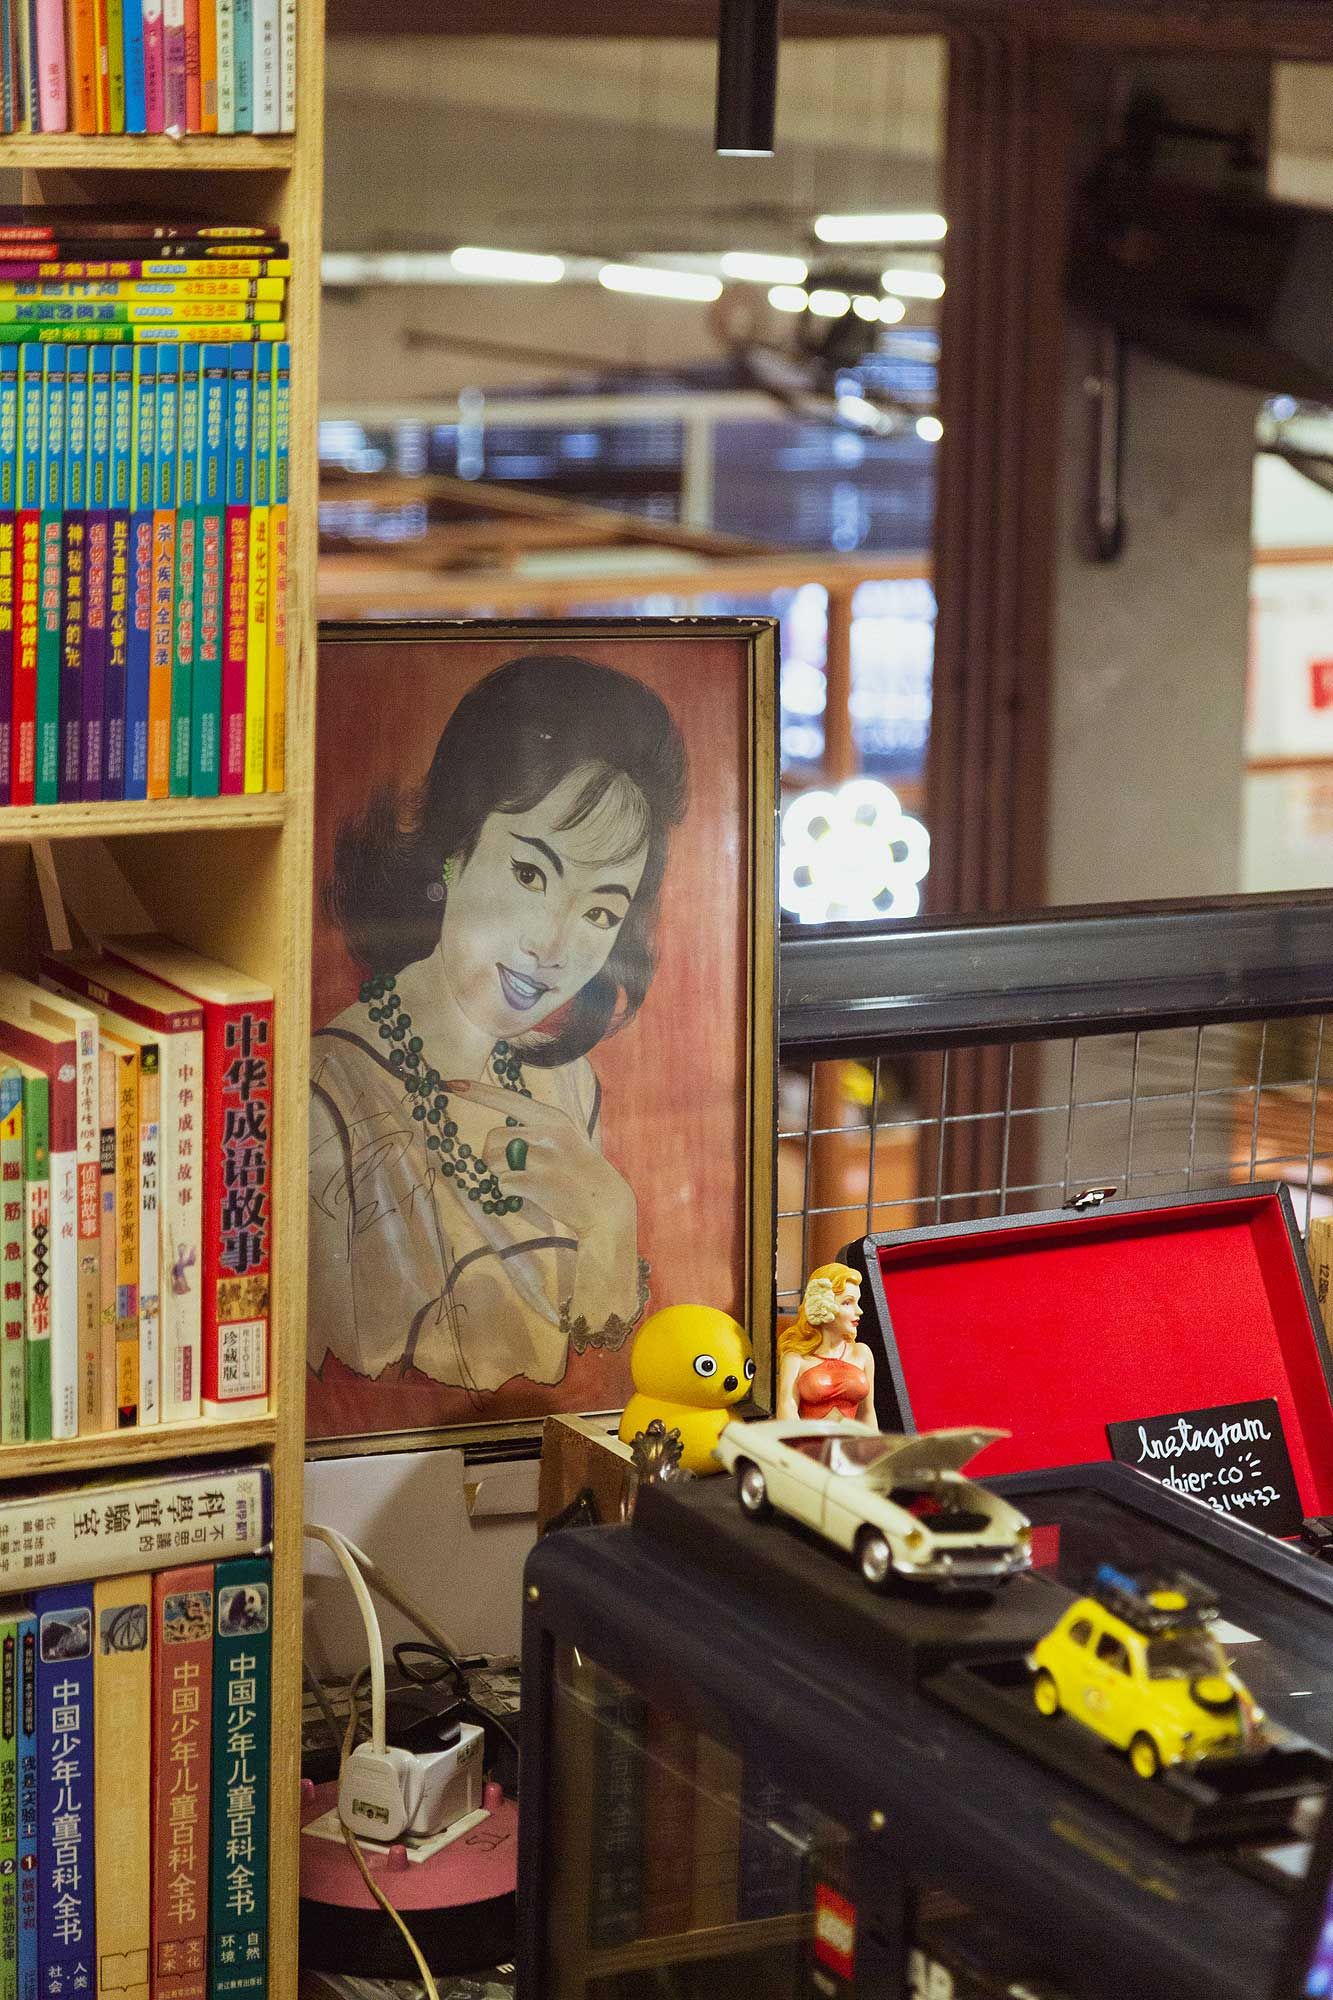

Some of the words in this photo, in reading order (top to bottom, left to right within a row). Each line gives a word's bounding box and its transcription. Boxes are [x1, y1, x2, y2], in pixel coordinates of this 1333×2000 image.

[155, 524, 171, 666] 杀人疾病全记录
[7, 1118, 16, 1136] 1
[177, 1063, 194, 1207] 中华成语故事
[221, 1014, 268, 1274] 中华成语故事
[79, 1164, 98, 1237] 侦探故事
[142, 1150, 157, 1211] 歇后语
[3, 1161, 22, 1340] 腦筋急轉彎
[31, 1293, 49, 1335] 故事
[222, 1330, 238, 1382] 珍藏版
[1138, 1417, 1272, 1463] Instagram
[73, 1489, 226, 1541] 科學實驗室
[138, 1523, 225, 1553] 不可思議的
[167, 1660, 200, 1925] 中国少年儿童百科全书
[225, 1652, 258, 1916] 中国少年儿童百科全书
[50, 1677, 83, 1945] 中国少年儿童百科全书
[4, 1860, 13, 1874] 2
[25, 1857, 33, 1871] 1
[163, 1943, 177, 1972] 艺术
[186, 1940, 201, 1969] 文化
[220, 1934, 236, 1964] 环境
[246, 1932, 261, 1961] 自然
[48, 1965, 63, 1993] 社会
[73, 1961, 88, 1989] 人类
